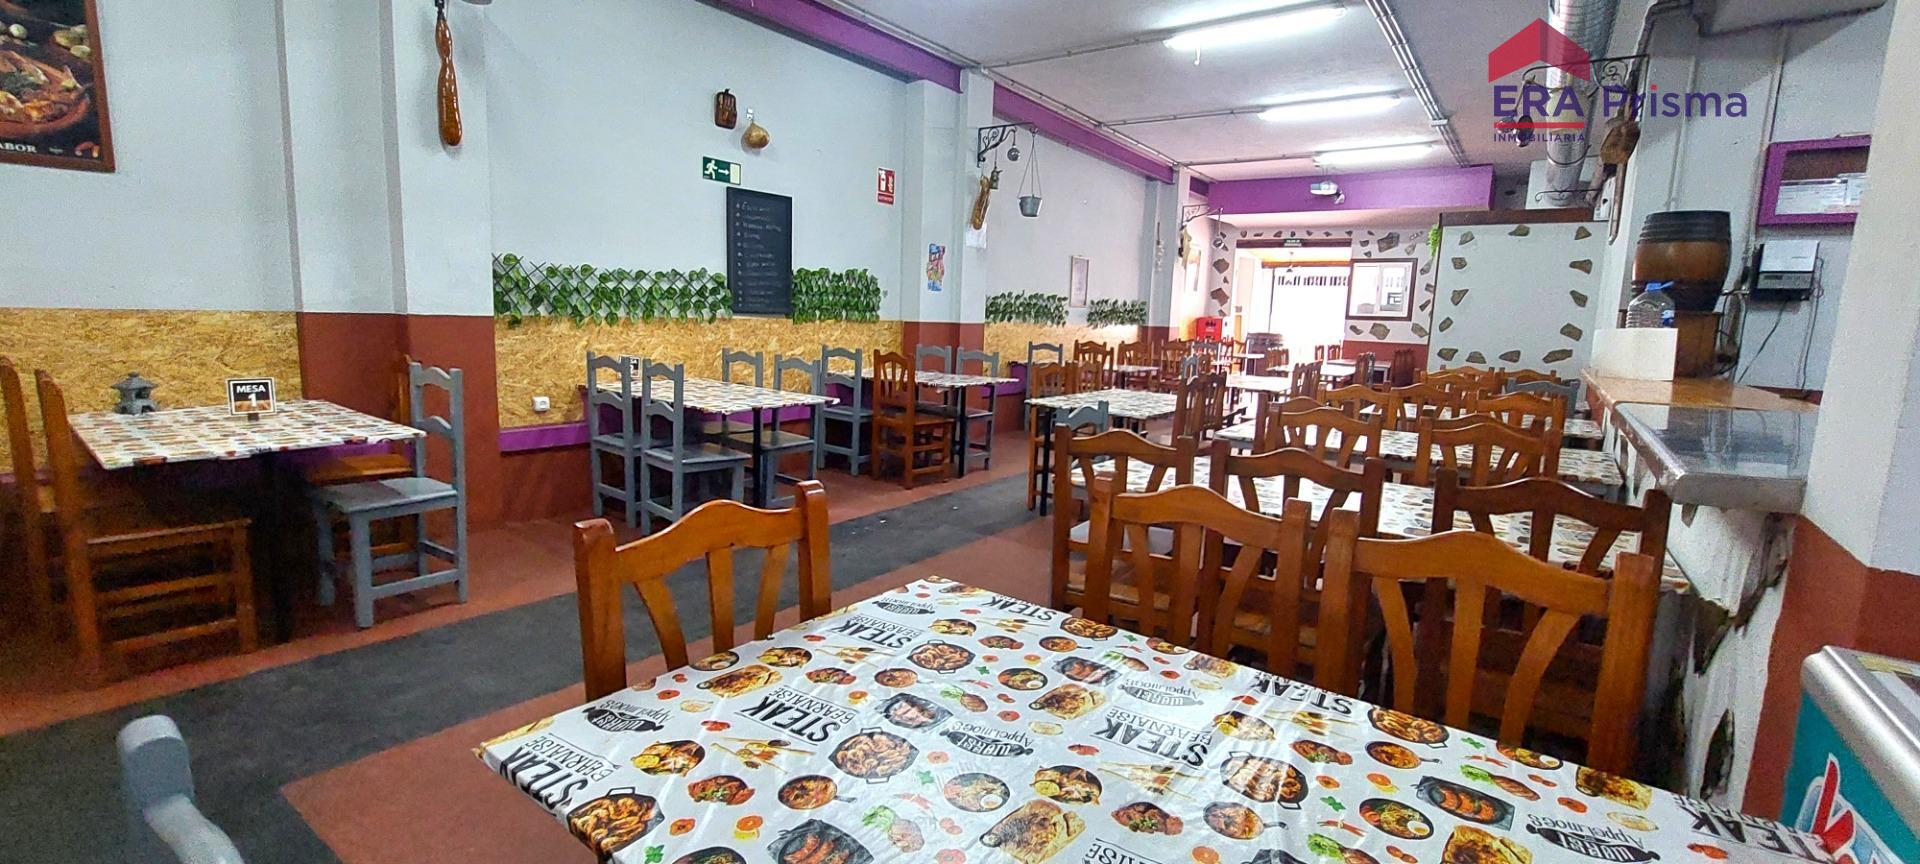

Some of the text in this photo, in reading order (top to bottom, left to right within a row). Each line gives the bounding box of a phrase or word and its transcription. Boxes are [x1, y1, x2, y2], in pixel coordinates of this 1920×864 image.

[236, 384, 266, 394] MESA
[247, 393, 257, 407] 1
[979, 595, 1057, 621] STEAK
[827, 620, 912, 649] STEAK
[849, 615, 922, 638] BEARNAISE
[767, 687, 855, 725] BEARNAISE
[1246, 679, 1353, 715] STEAK
[740, 696, 841, 742] STEAK
[1106, 708, 1212, 745] BEARNAISE
[522, 735, 614, 782] BEARNAISE
[1093, 718, 1208, 767] STEAK
[498, 747, 589, 811] STEAK
